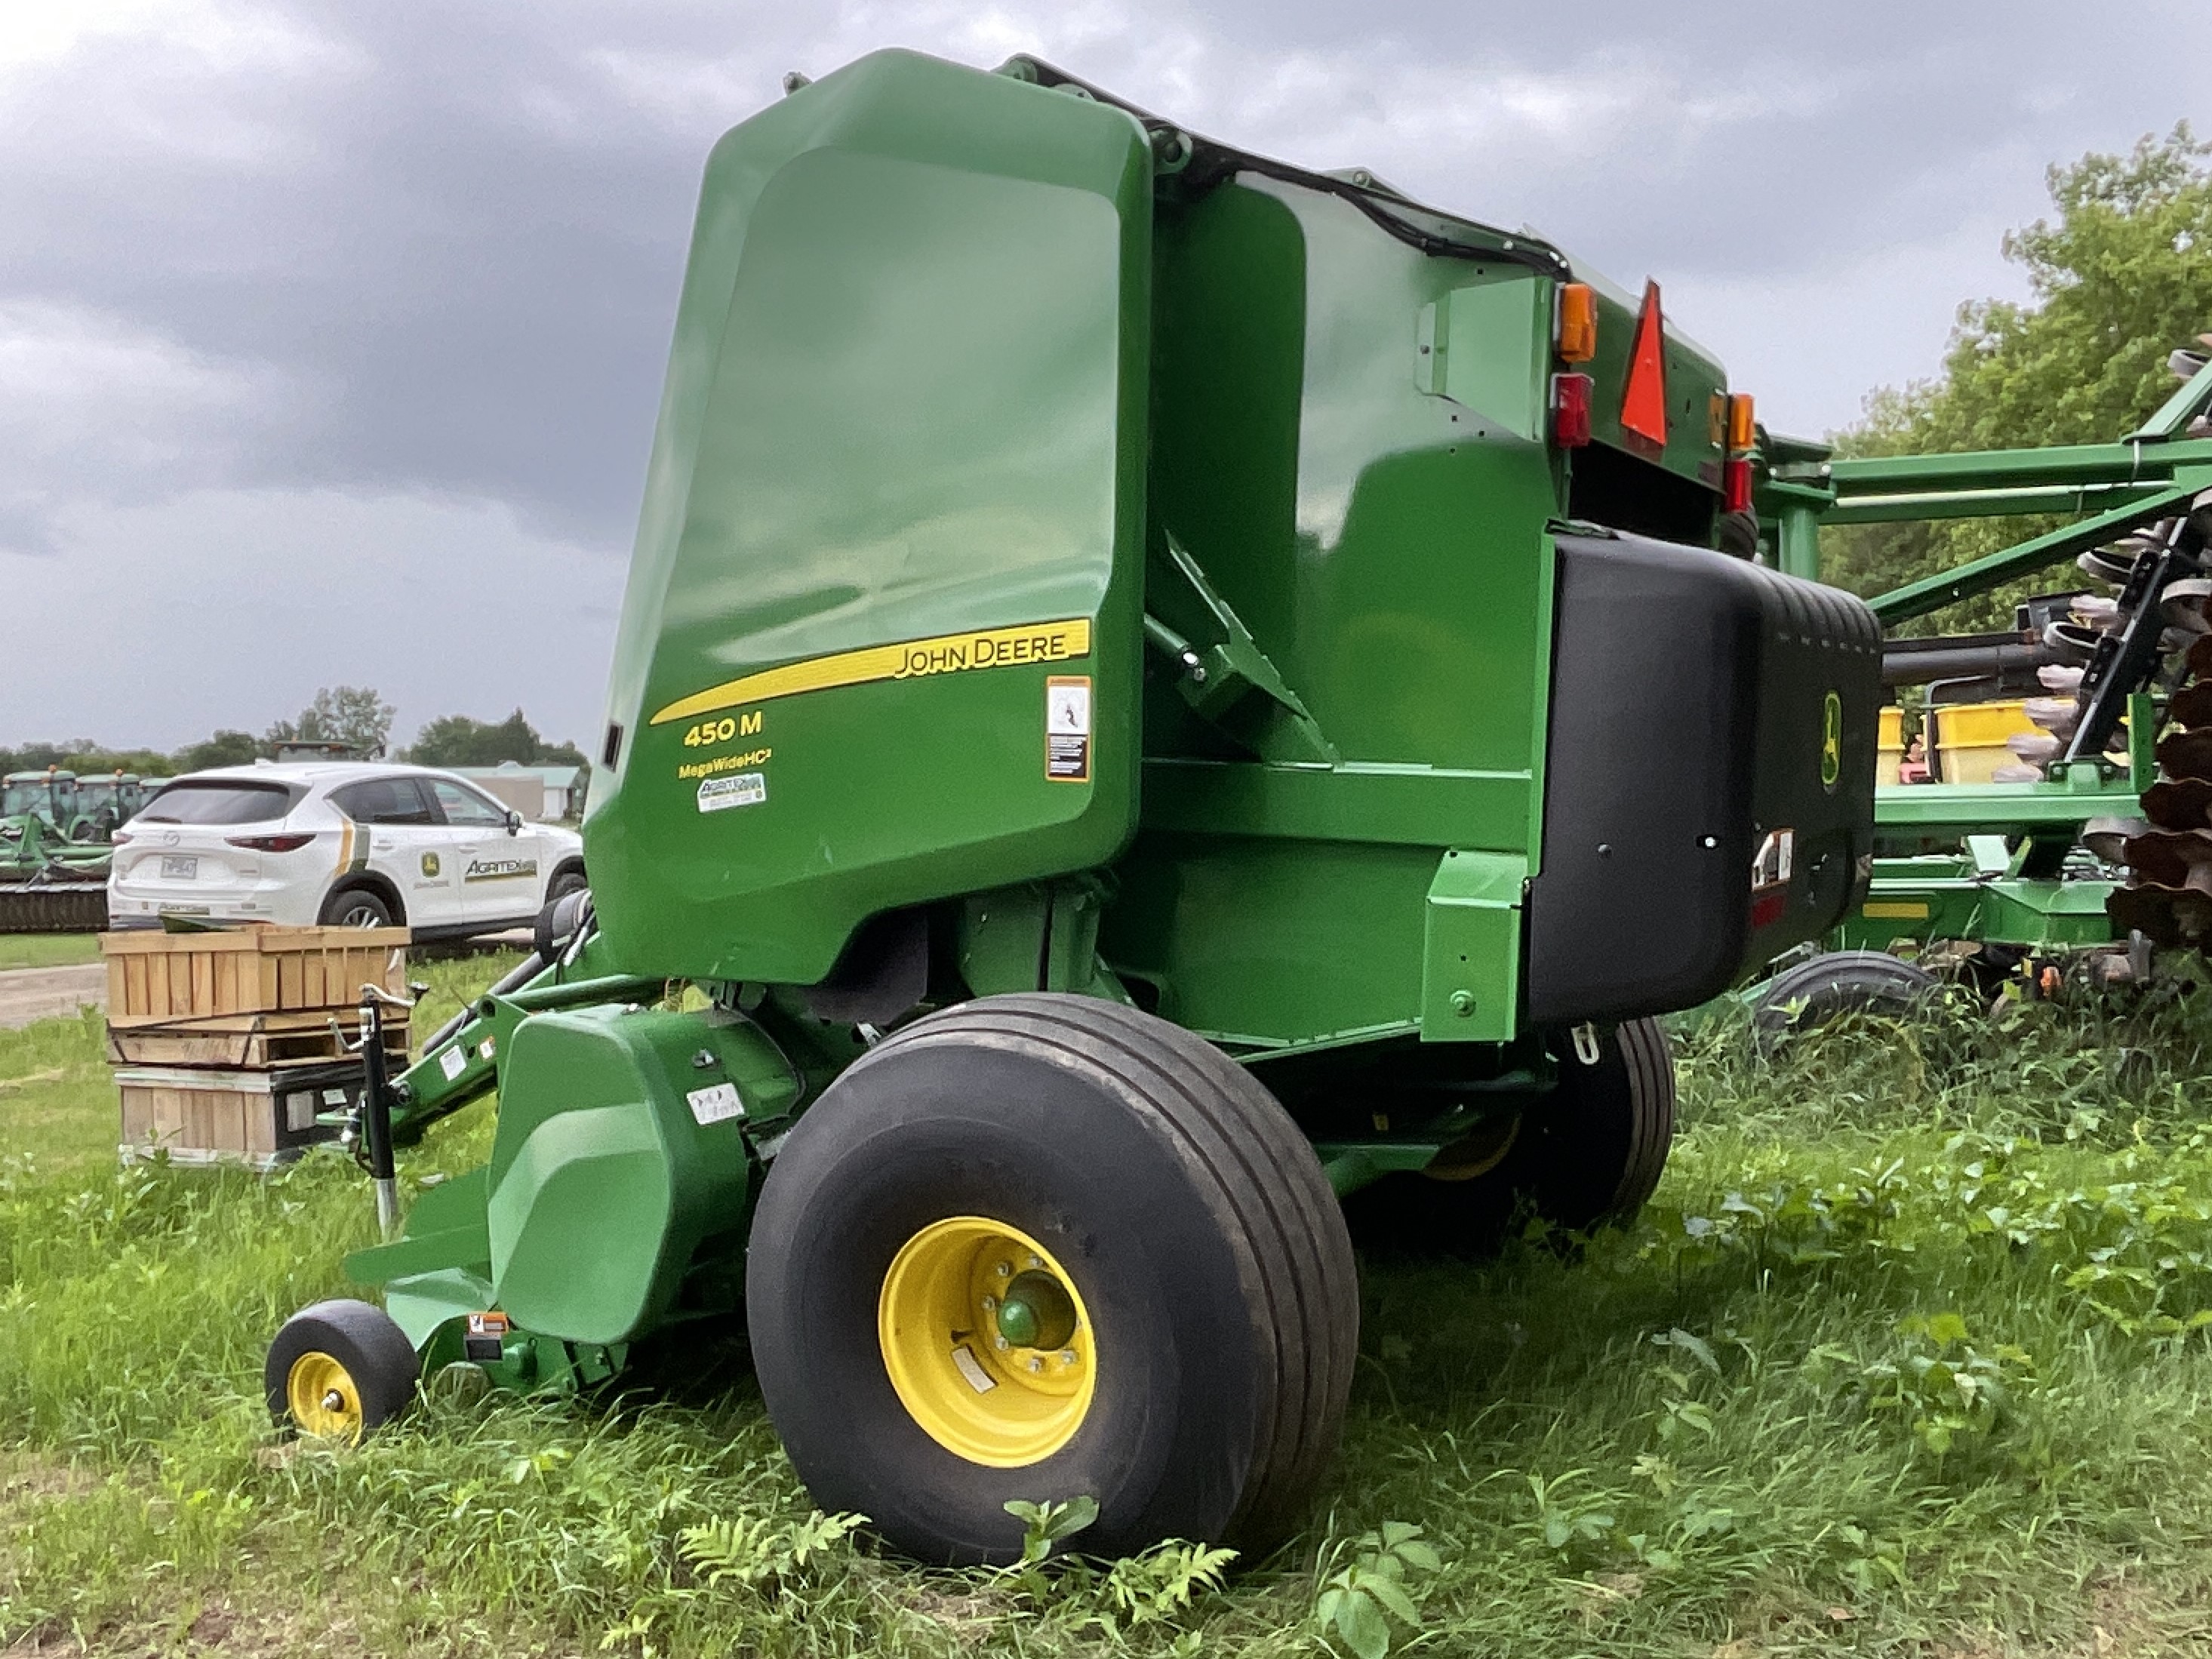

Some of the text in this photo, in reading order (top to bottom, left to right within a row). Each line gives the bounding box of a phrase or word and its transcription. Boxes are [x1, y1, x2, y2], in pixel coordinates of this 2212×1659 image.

[894, 633, 1066, 675] JOHN DEERE
[684, 710, 762, 747] 450 M
